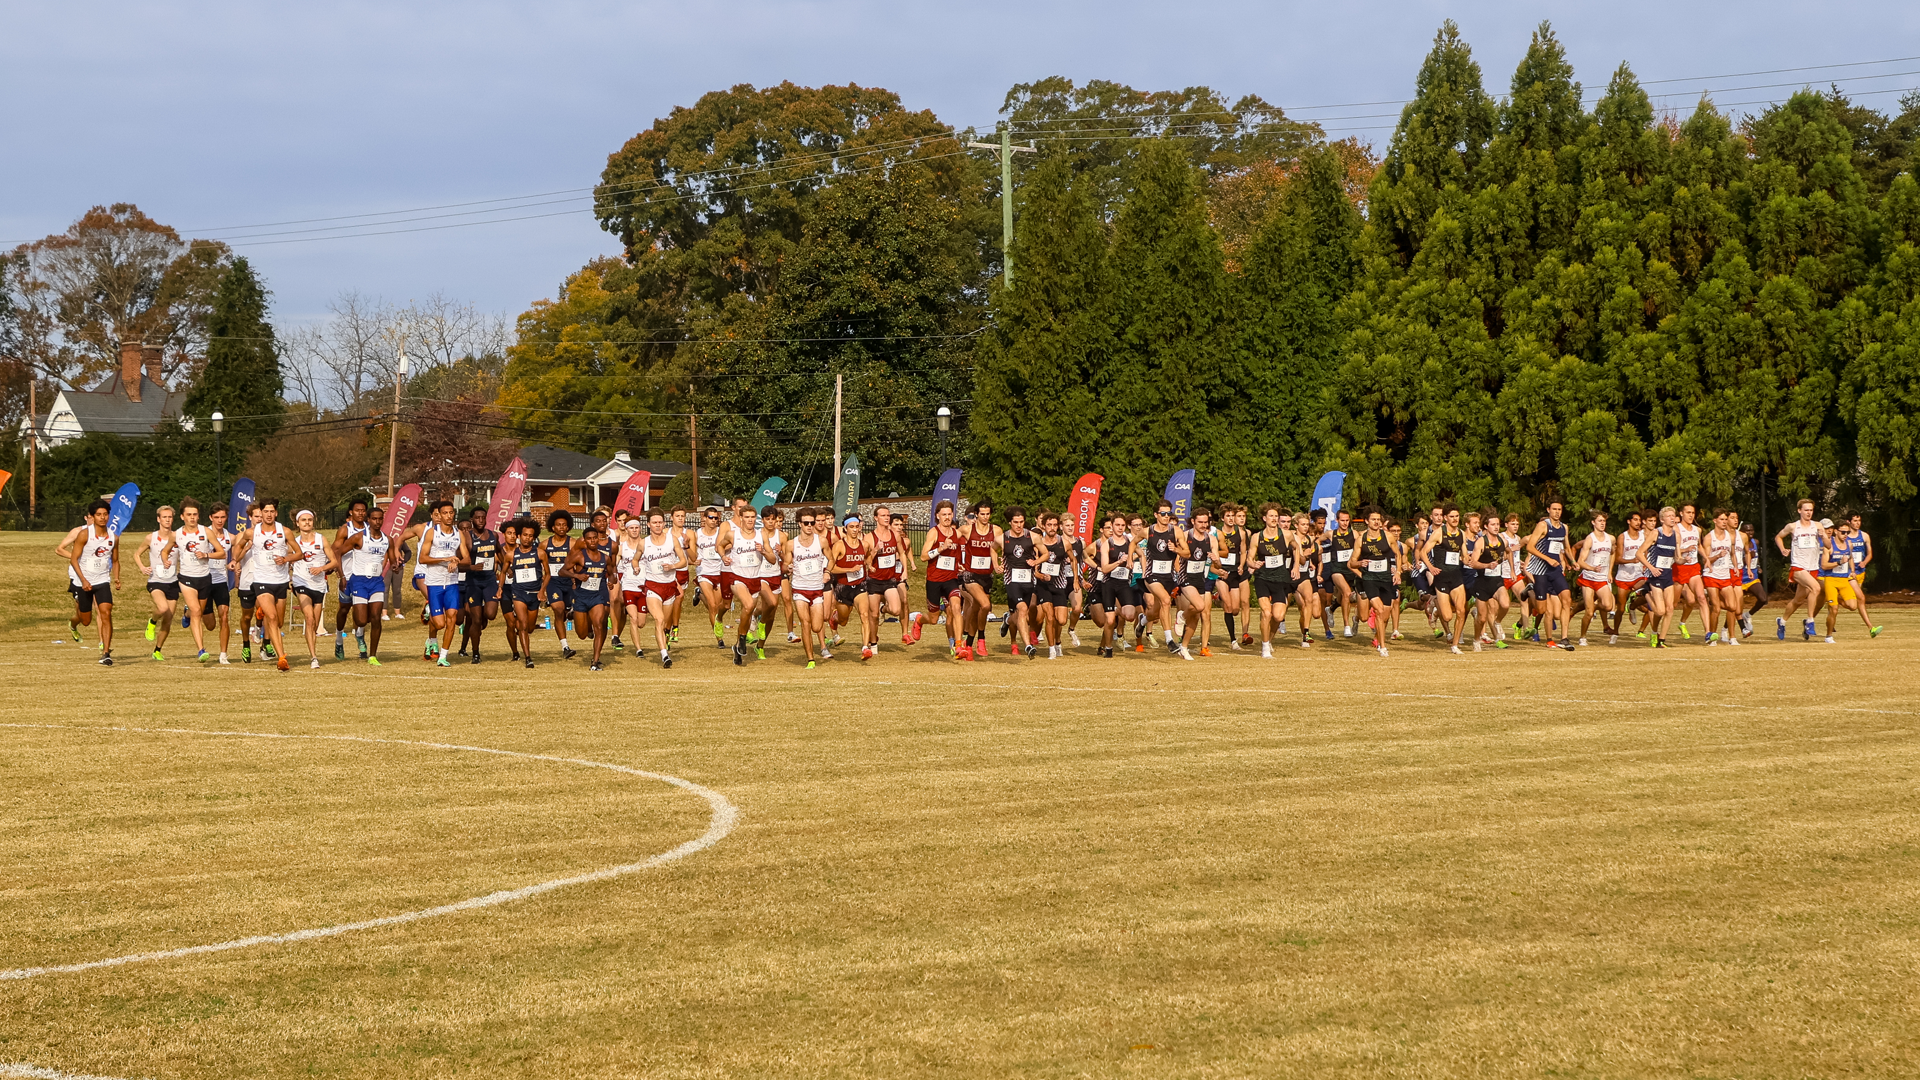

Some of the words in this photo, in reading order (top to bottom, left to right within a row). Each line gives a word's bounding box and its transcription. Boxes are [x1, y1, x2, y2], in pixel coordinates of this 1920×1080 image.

[509, 471, 523, 481] CAA
[845, 467, 859, 475] CAA
[628, 483, 644, 493] CAA
[941, 483, 956, 491] CAA
[1079, 486, 1096, 495] CAA
[237, 491, 252, 503] CAA
[763, 489, 777, 500] CAA
[847, 479, 855, 506] MARY
[119, 494, 132, 508] CAA
[400, 495, 414, 508] CAA
[1078, 498, 1090, 534] BROOK
[389, 506, 408, 539] STON
[971, 540, 993, 548] ELON
[882, 546, 897, 554] LON
[647, 552, 672, 562] Charleston
[846, 554, 865, 562] ELON
